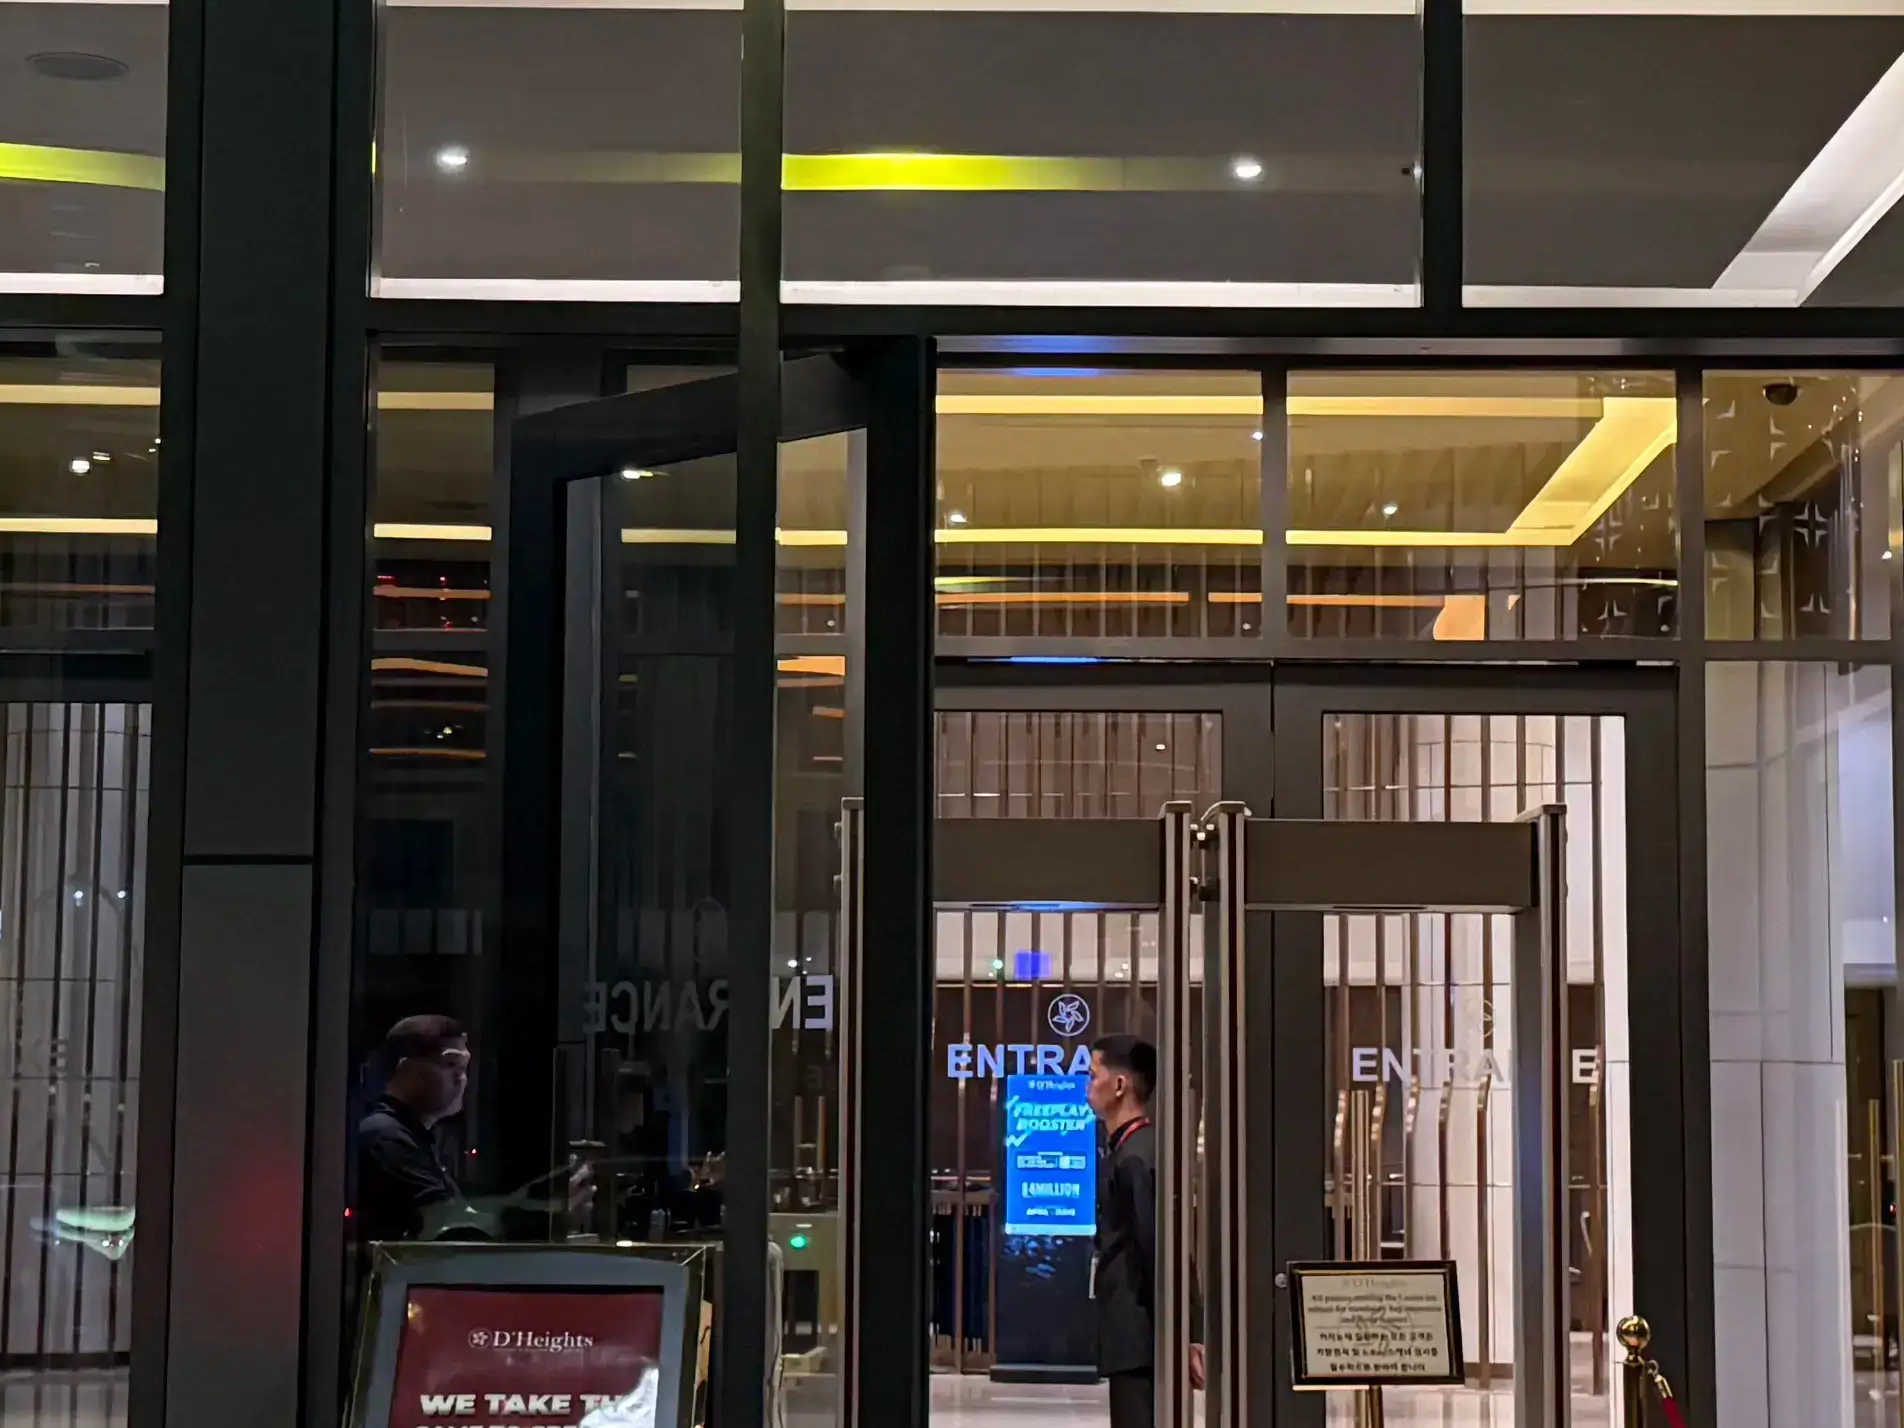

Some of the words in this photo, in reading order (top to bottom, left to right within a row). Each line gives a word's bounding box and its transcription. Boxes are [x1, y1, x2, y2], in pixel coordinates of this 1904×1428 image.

[493, 1331, 594, 1353] D'Heights
[420, 1394, 477, 1415] WE
[484, 1394, 572, 1415] TAKE
